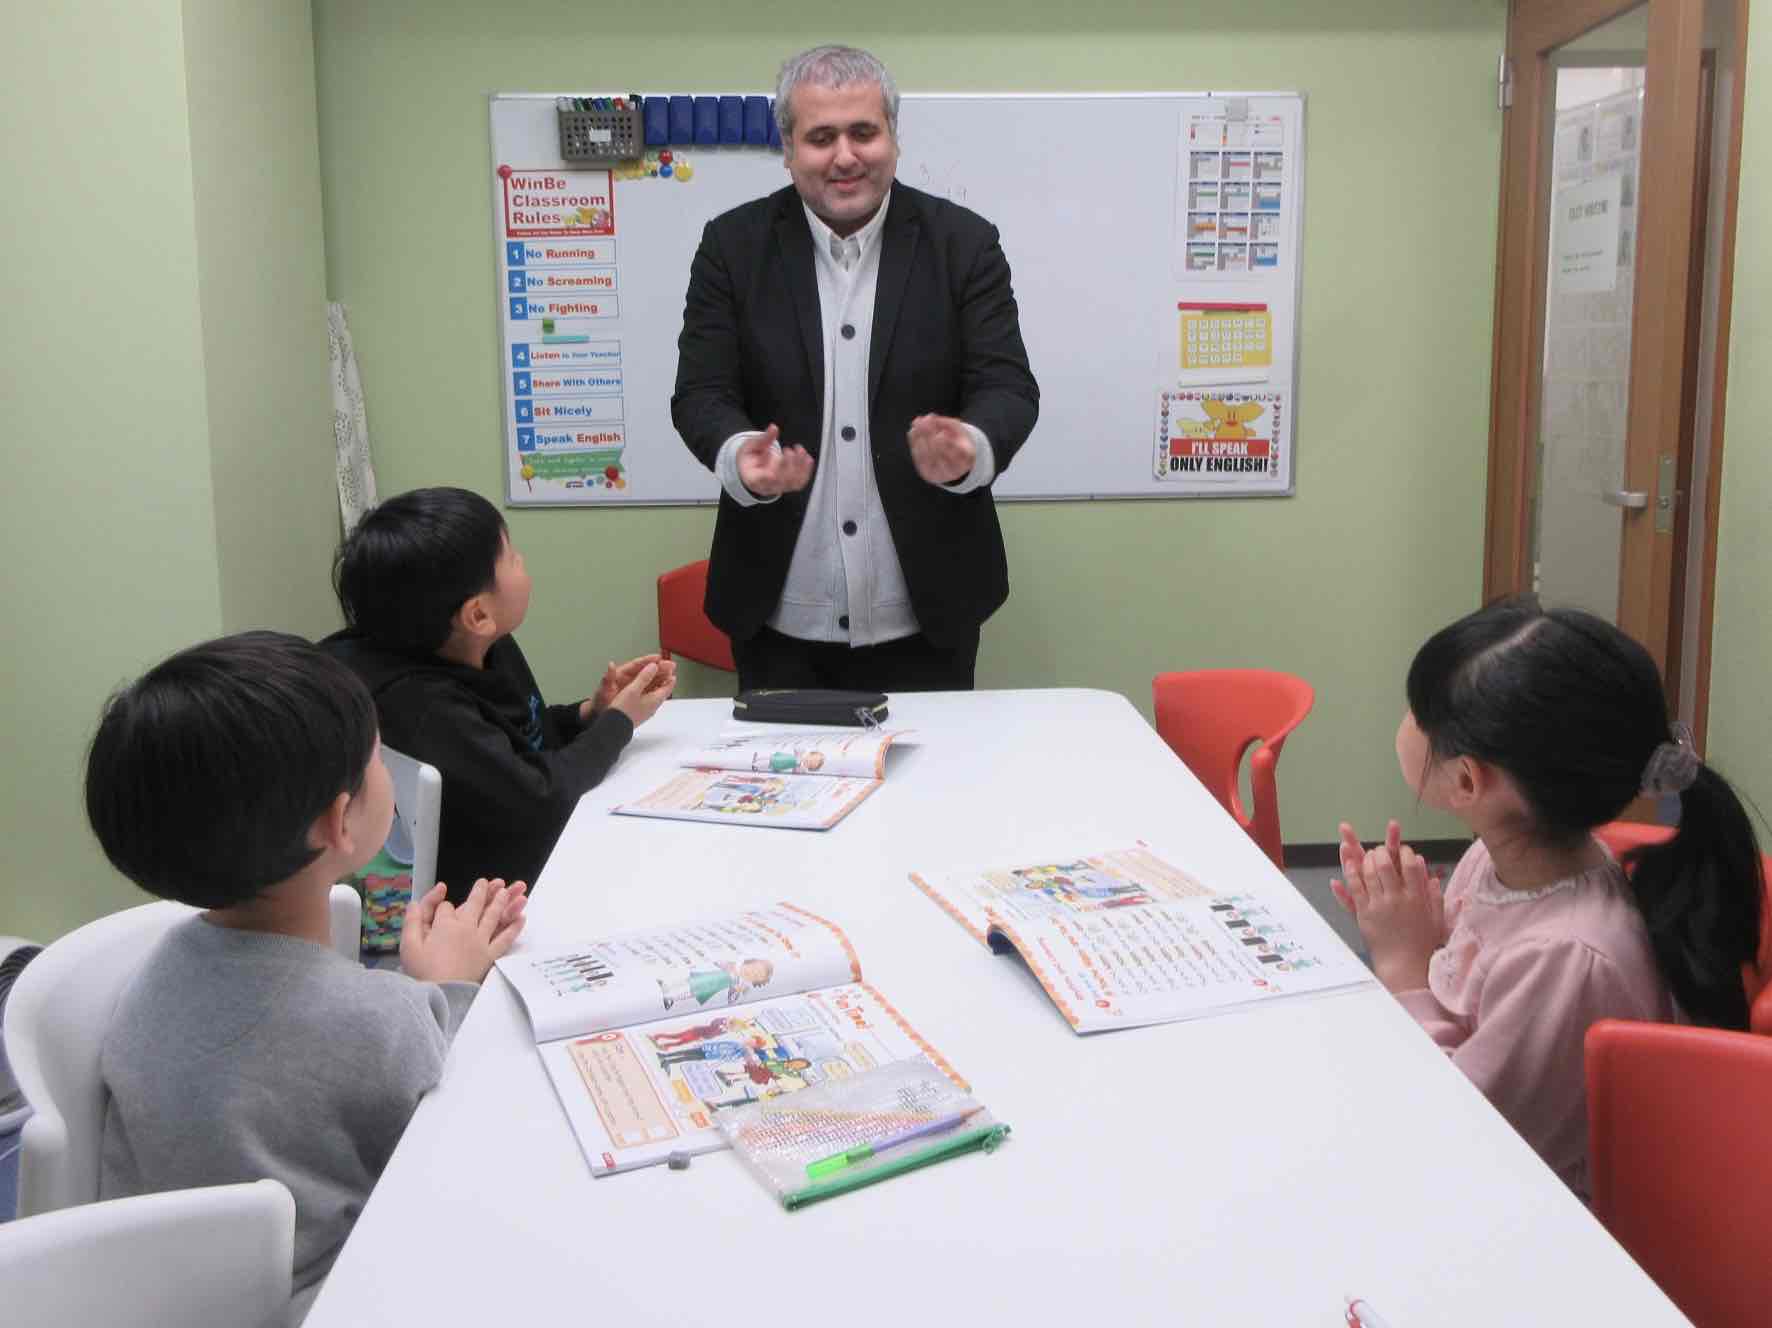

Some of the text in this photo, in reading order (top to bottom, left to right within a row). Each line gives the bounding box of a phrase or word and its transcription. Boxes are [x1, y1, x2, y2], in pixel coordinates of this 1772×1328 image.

[510, 177, 566, 190] WinBe
[512, 194, 605, 207] Classroom
[512, 211, 561, 224] Rules
[512, 248, 595, 260] 1 No Running
[512, 276, 612, 288] 2 No Screaming
[514, 303, 598, 315] 3 No Fighting
[517, 351, 526, 361] 4
[531, 351, 560, 360] Listen
[519, 377, 622, 389] 5 Share With Others
[520, 405, 593, 417] 6 Sit Nicely
[521, 432, 621, 445] 7 Speak English
[1191, 442, 1248, 455] I'LL SPEAK
[1170, 457, 1268, 472] ONLY ENGLISH!
